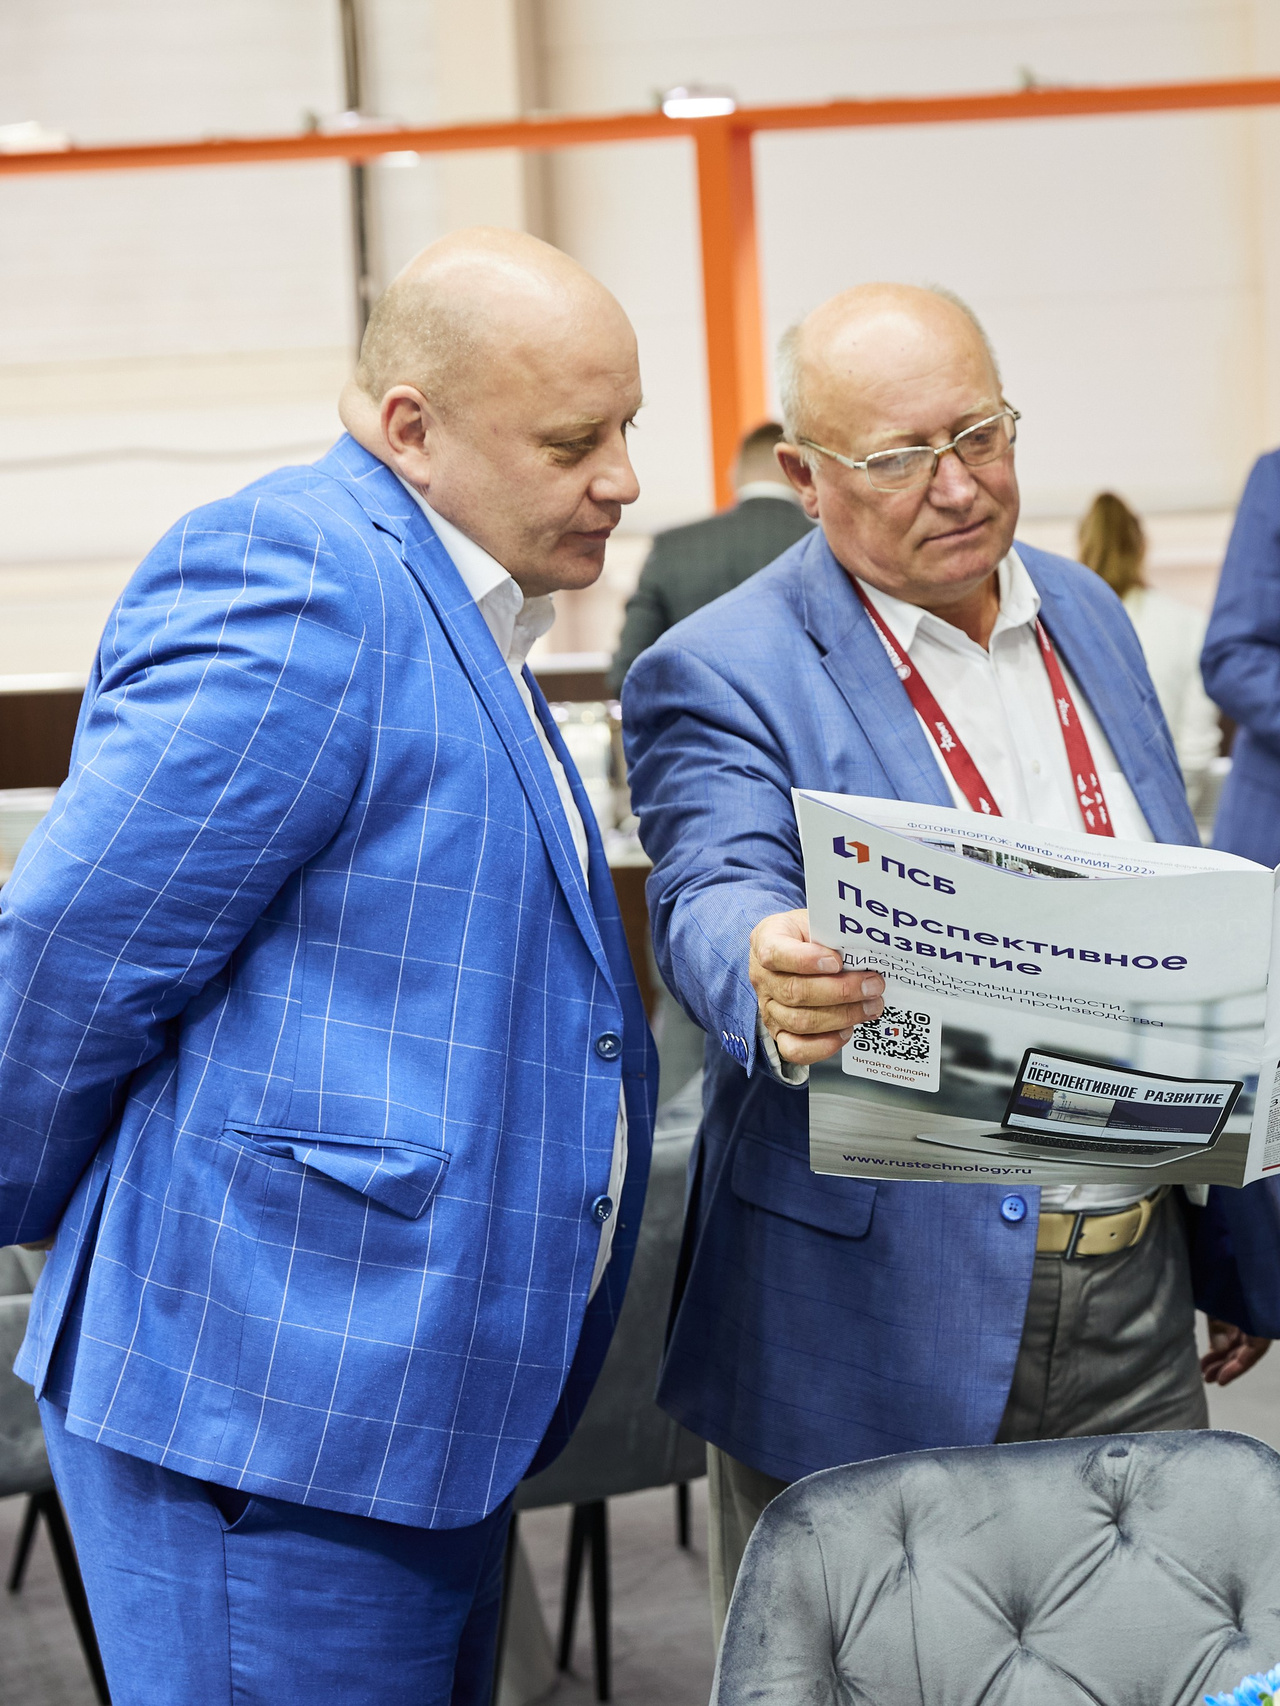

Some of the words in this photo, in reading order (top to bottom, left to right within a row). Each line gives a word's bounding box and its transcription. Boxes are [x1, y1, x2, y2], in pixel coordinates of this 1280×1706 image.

[907, 822, 1011, 846] ФОТОРЕПОРТАЖ:
[1015, 841, 1053, 856] МВТФ
[881, 855, 956, 895] ПСБ
[838, 879, 1188, 971] Перспективное
[839, 913, 1042, 976] развитие
[843, 953, 1013, 1001] Диверсификации
[1020, 998, 1164, 1028] производства
[852, 1055, 892, 1070] Читайте
[894, 1066, 930, 1079] онлайн
[866, 1067, 883, 1078] по
[885, 1070, 916, 1082] ссылке
[1027, 1067, 1138, 1099] ПЕРСПЕКТИВНОЕ
[1144, 1089, 1224, 1105] РАЗВИТИЕ
[843, 1154, 1032, 1175] www.rustechnology.ru
